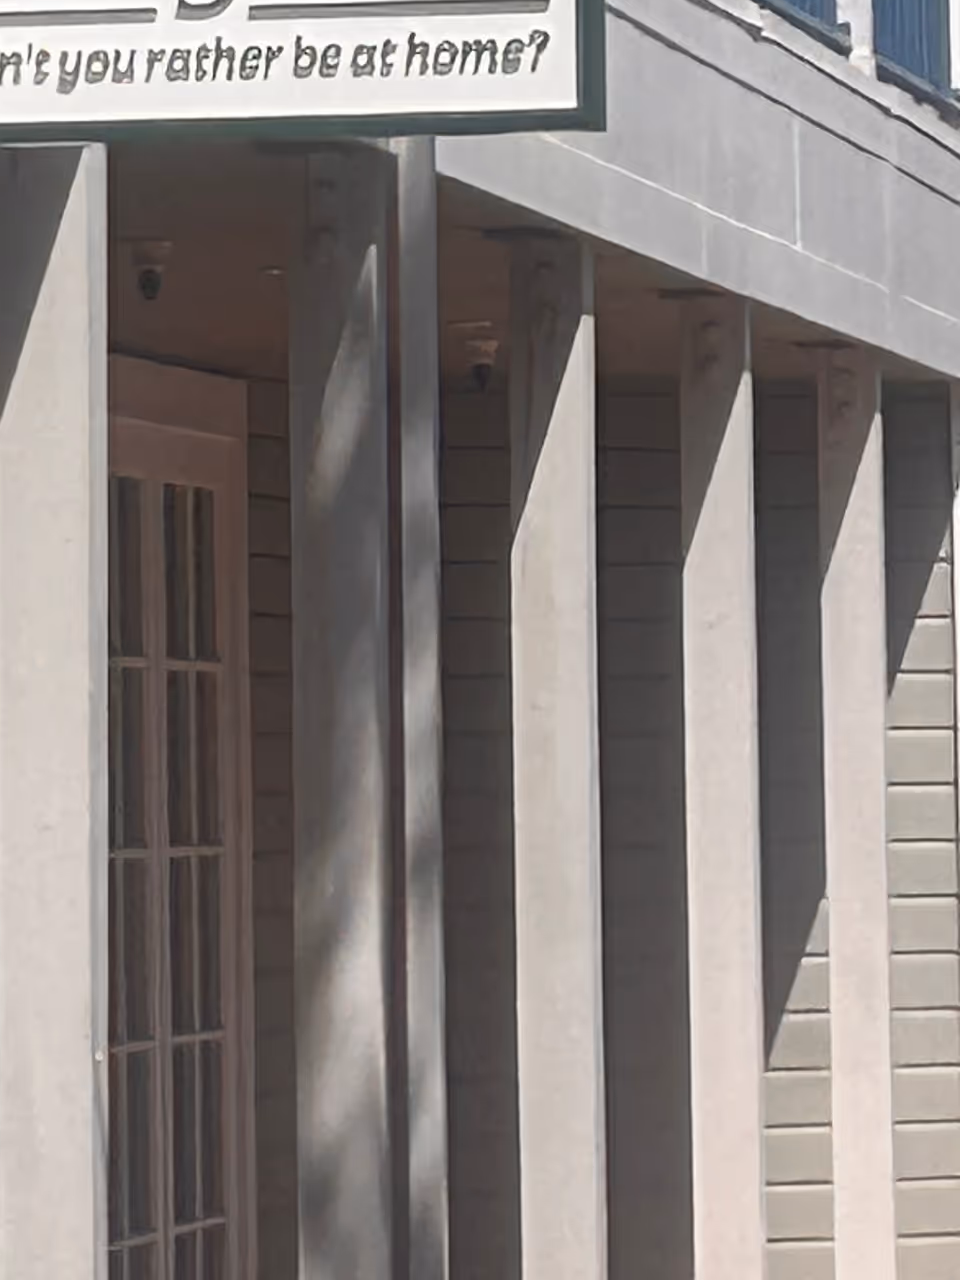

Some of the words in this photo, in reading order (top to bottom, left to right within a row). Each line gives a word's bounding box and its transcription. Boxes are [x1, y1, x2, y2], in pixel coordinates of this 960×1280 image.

[56, 49, 136, 94] you
[144, 36, 284, 83] rather
[292, 35, 342, 79] be
[350, 39, 397, 78] at
[404, 29, 551, 76] home?
